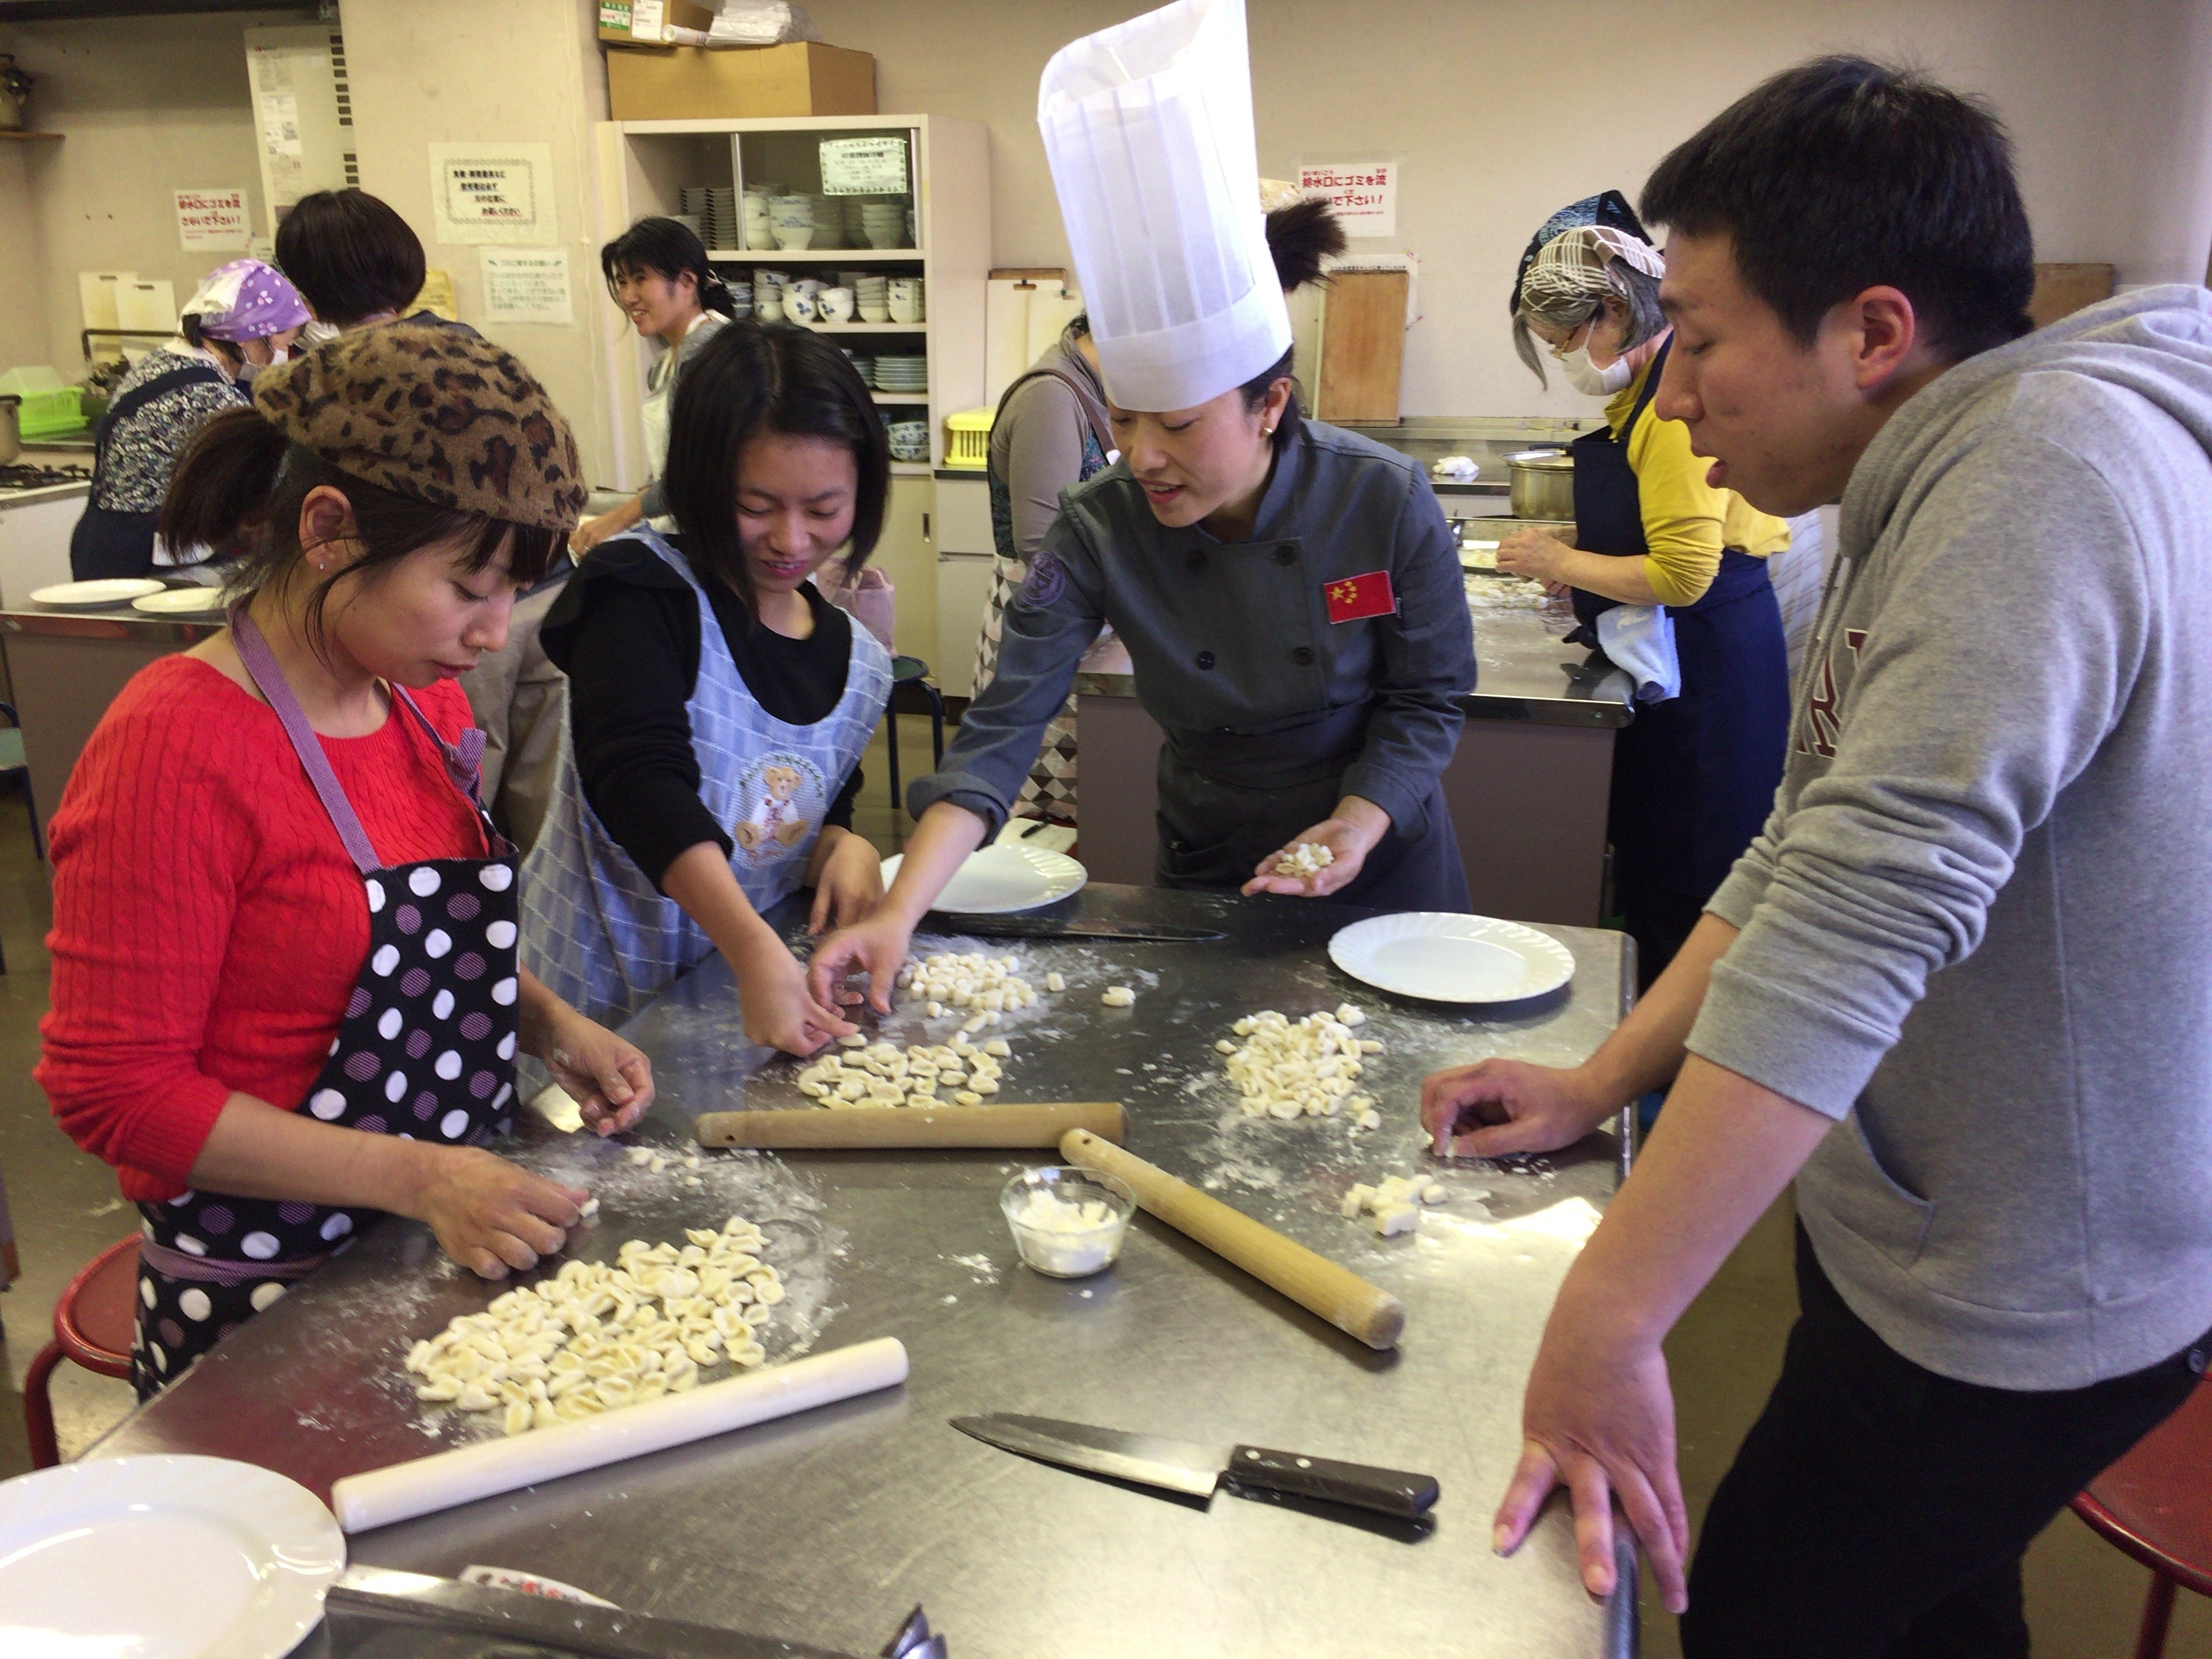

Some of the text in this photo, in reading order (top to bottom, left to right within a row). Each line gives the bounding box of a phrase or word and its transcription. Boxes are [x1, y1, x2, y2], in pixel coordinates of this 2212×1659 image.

[1303, 175, 1387, 188] 排水口にゴミを流
